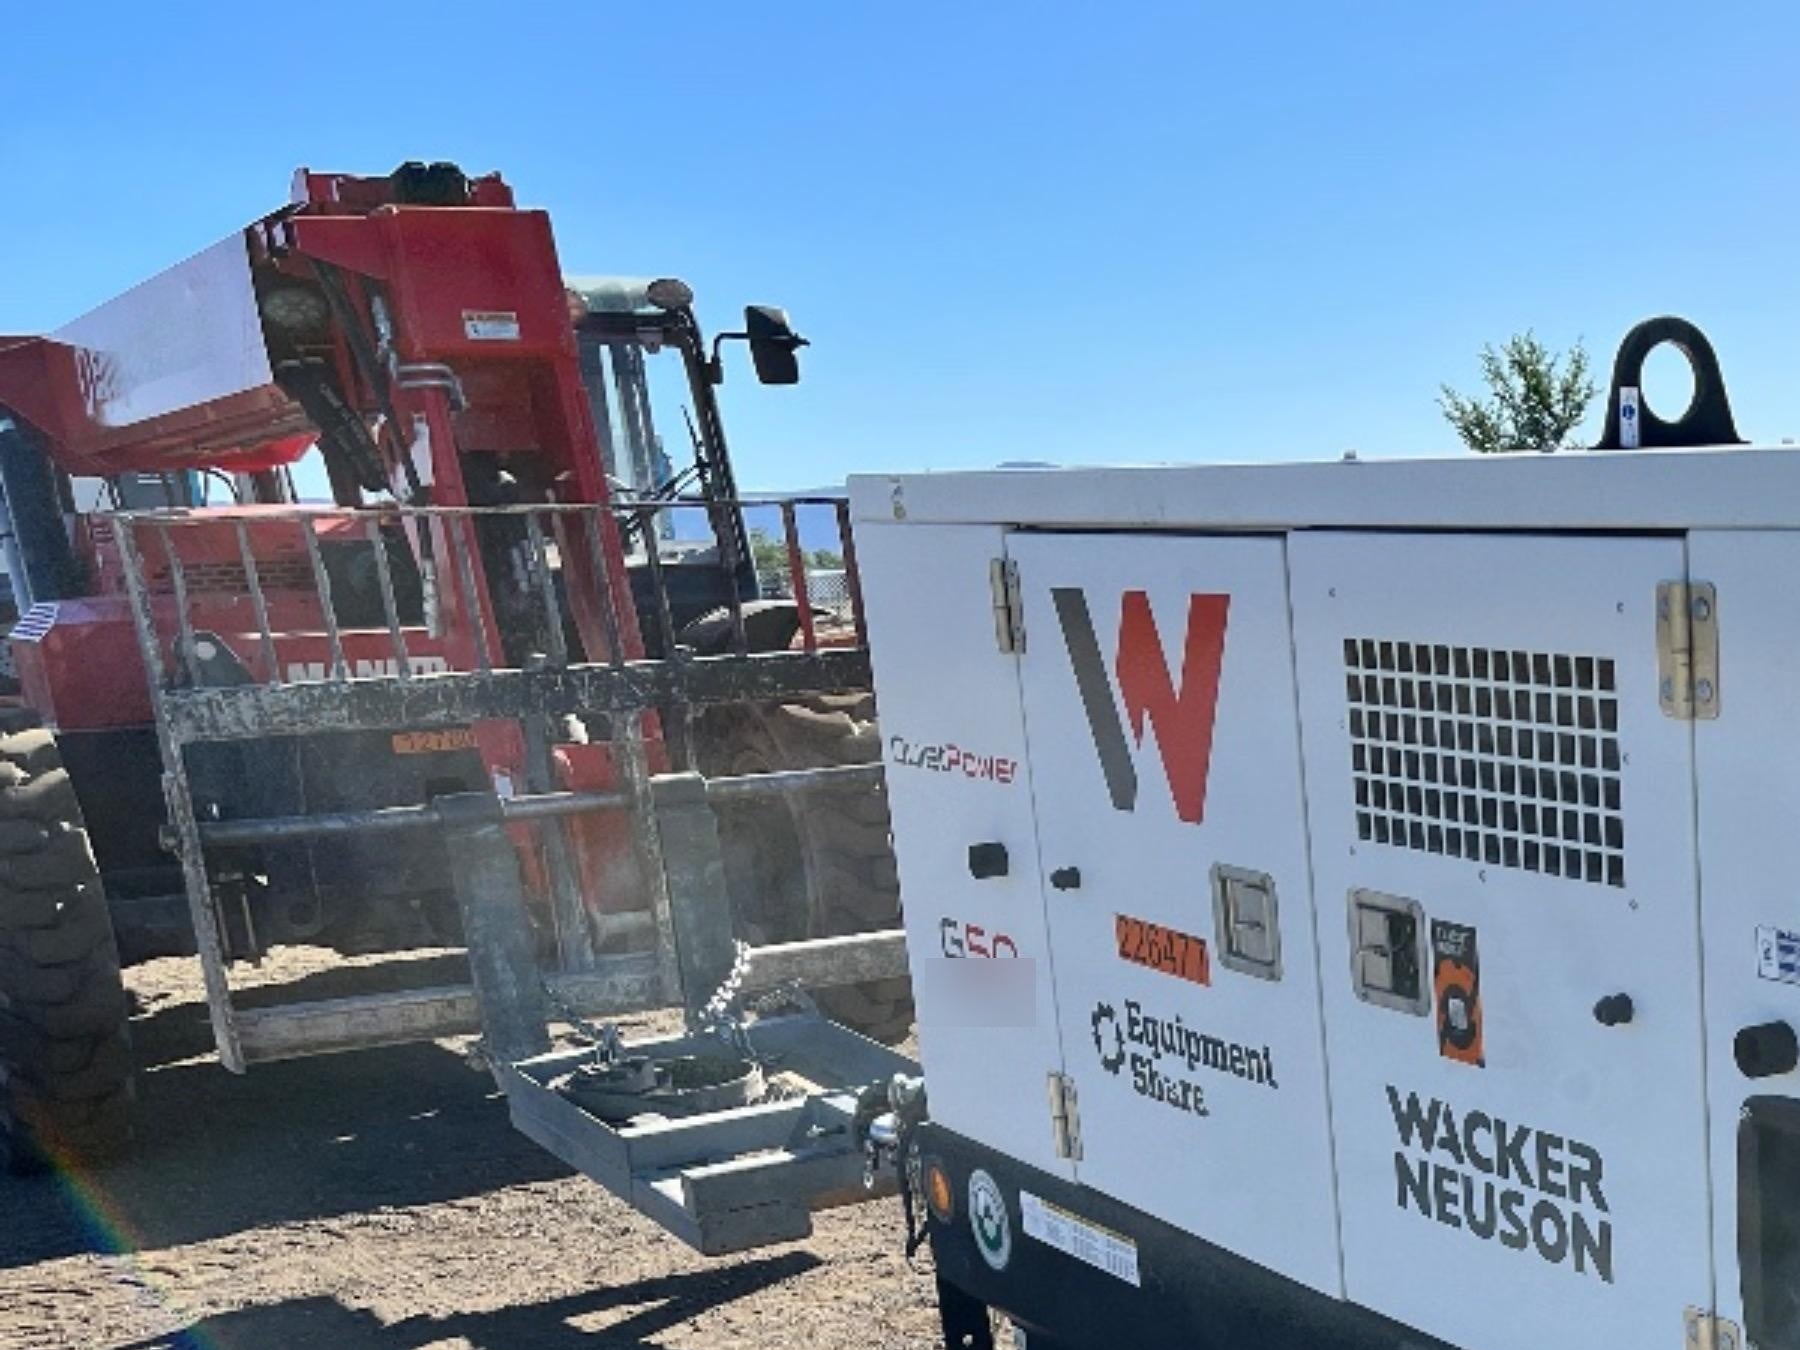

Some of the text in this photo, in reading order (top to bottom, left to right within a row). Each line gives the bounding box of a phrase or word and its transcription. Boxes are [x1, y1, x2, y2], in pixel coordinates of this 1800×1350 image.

[1125, 999, 1279, 1089] Equipment
[1130, 1053, 1209, 1116] Share
[1386, 1084, 1609, 1214] WACKER
[1395, 1151, 1613, 1284] NEUSON
